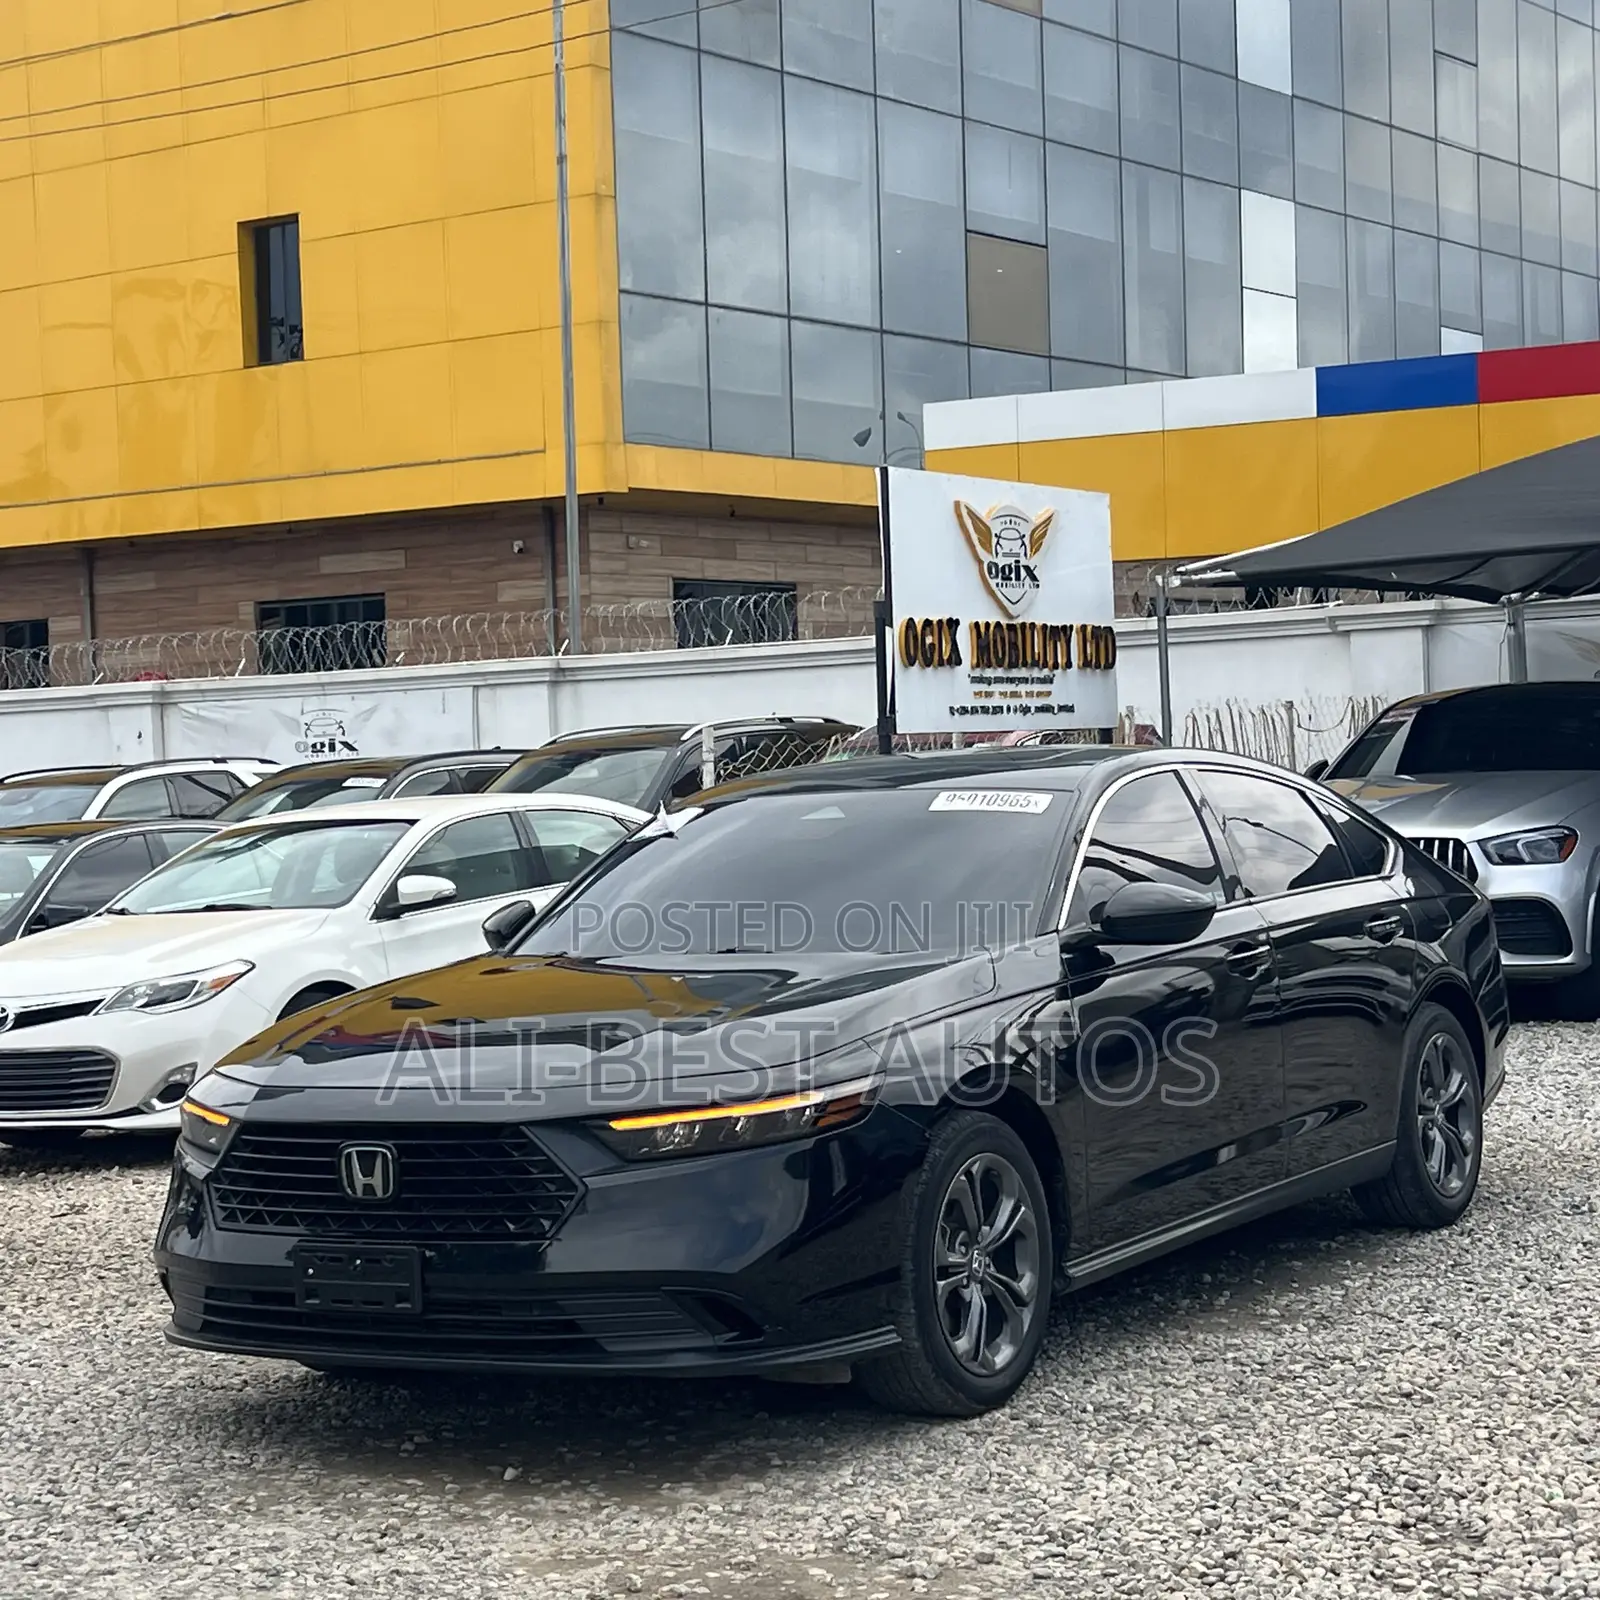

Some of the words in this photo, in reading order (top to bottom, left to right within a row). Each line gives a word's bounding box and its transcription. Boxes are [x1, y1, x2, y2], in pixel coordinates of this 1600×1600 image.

[899, 617, 963, 669] OGIX
[969, 621, 1074, 670] MOBILITY
[1076, 624, 1117, 670] LTD
